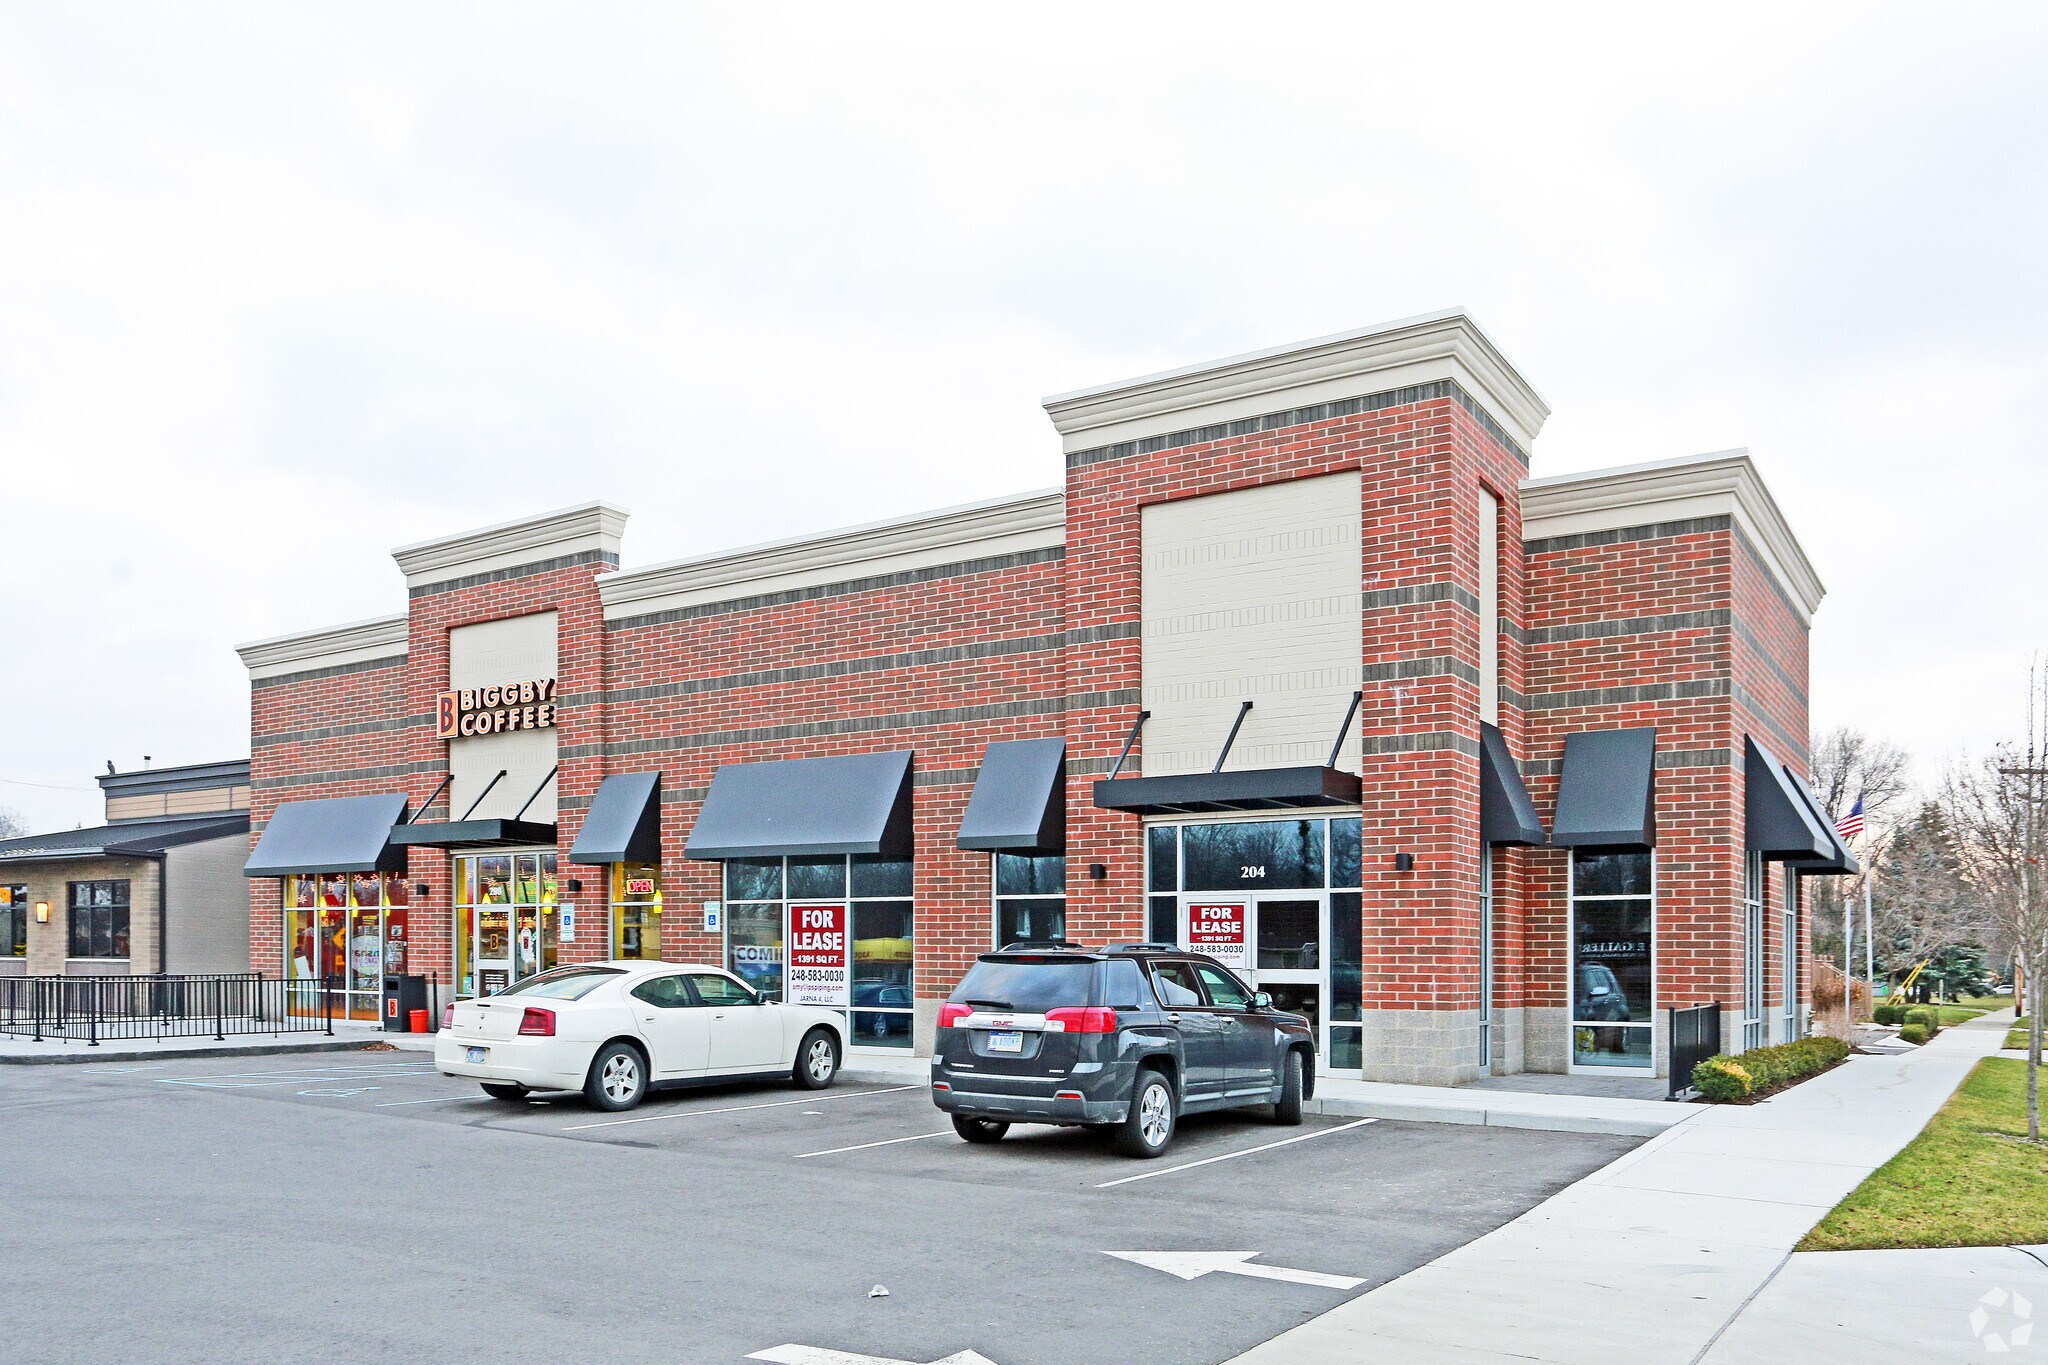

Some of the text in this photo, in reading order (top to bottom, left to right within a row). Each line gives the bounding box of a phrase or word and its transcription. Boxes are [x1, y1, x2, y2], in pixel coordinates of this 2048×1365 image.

[461, 678, 551, 711] BIGGBY
[440, 697, 453, 733] B
[461, 705, 550, 736] COFFEE
[1241, 866, 1266, 878] 204
[629, 881, 652, 892] OPEN
[802, 910, 834, 928] FOR
[1201, 907, 1232, 920] FOR
[1192, 921, 1241, 933] LEASE
[793, 932, 843, 950] LEASE
[736, 947, 782, 960] COMI
[1190, 945, 1244, 953] 248-583-0030
[797, 955, 839, 963] 1391 SQ FT
[791, 969, 844, 982] 248-583-0030
